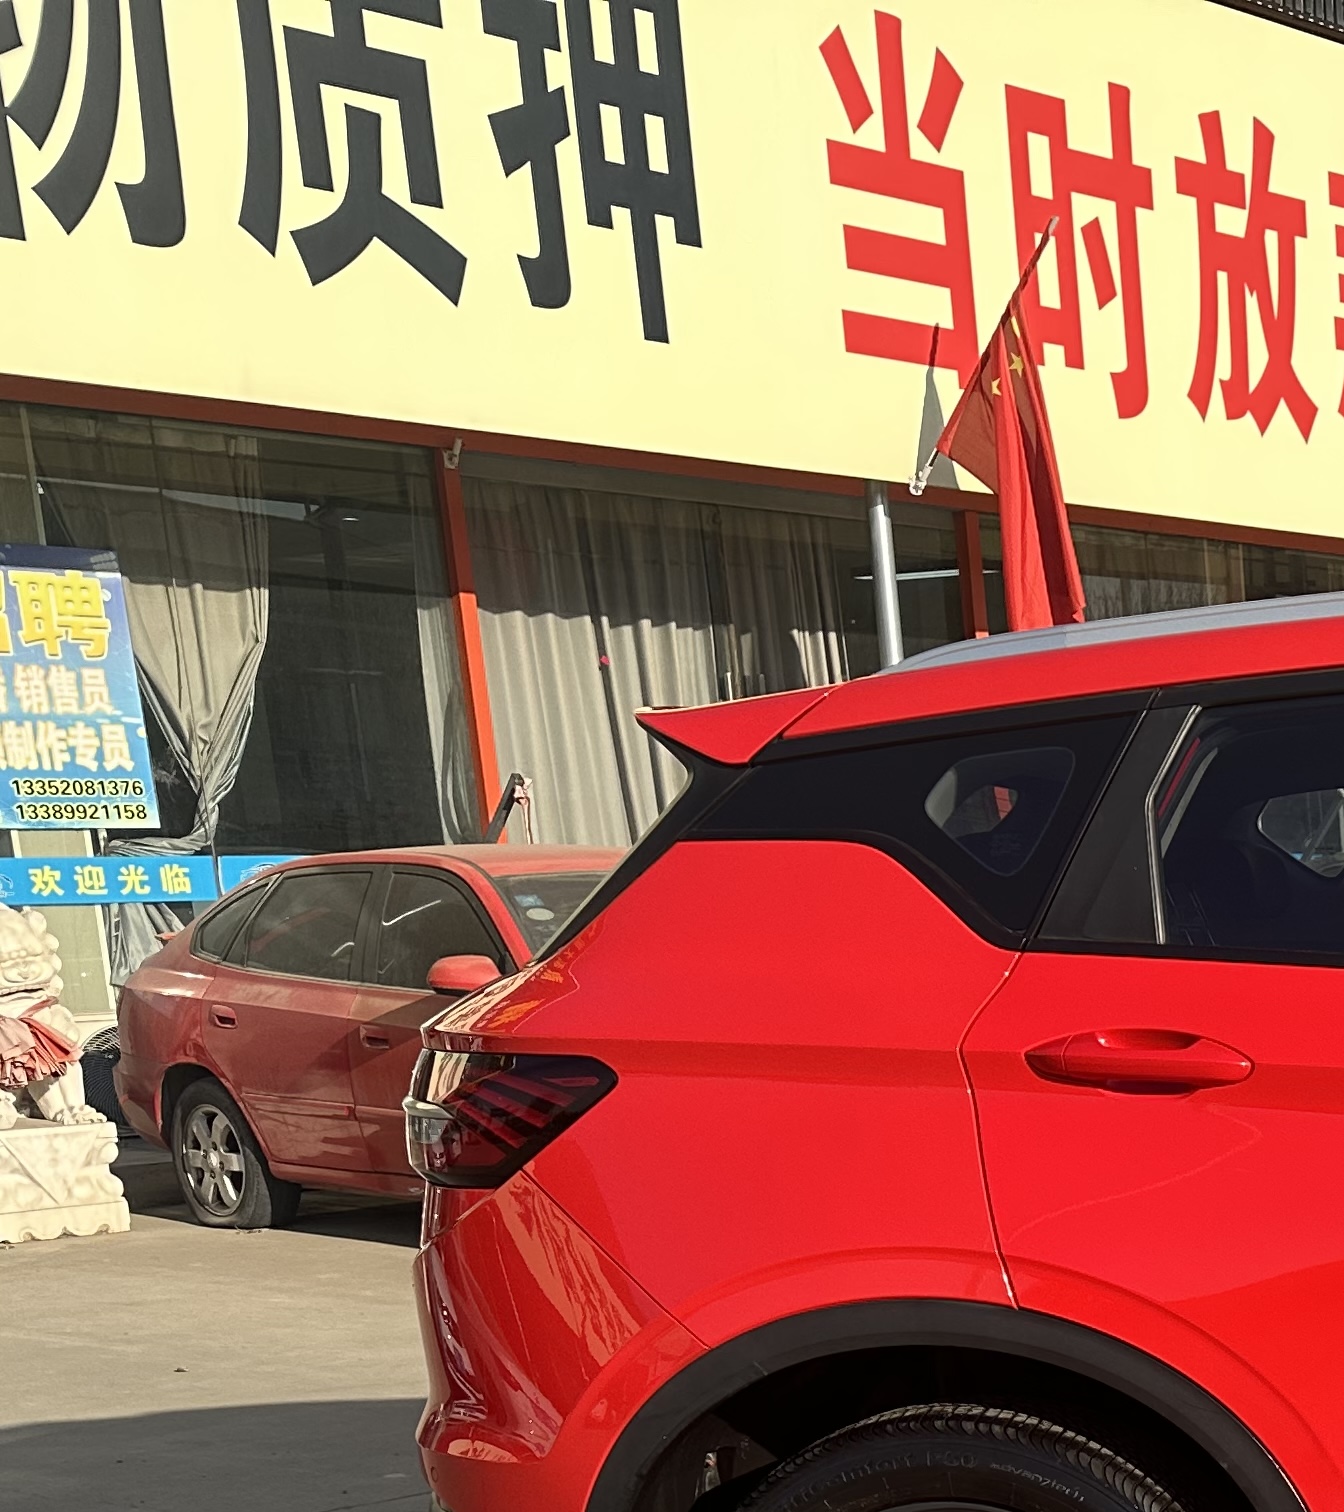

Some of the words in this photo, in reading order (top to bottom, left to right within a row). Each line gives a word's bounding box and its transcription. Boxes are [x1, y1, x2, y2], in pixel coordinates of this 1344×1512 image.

[0, 570, 112, 661] 聘
[13, 661, 115, 716] 销售员
[0, 719, 135, 773] 制作专员
[11, 779, 144, 797] 13352081376
[15, 803, 148, 821] 13389921158
[28, 863, 192, 897] 欢迎光临
